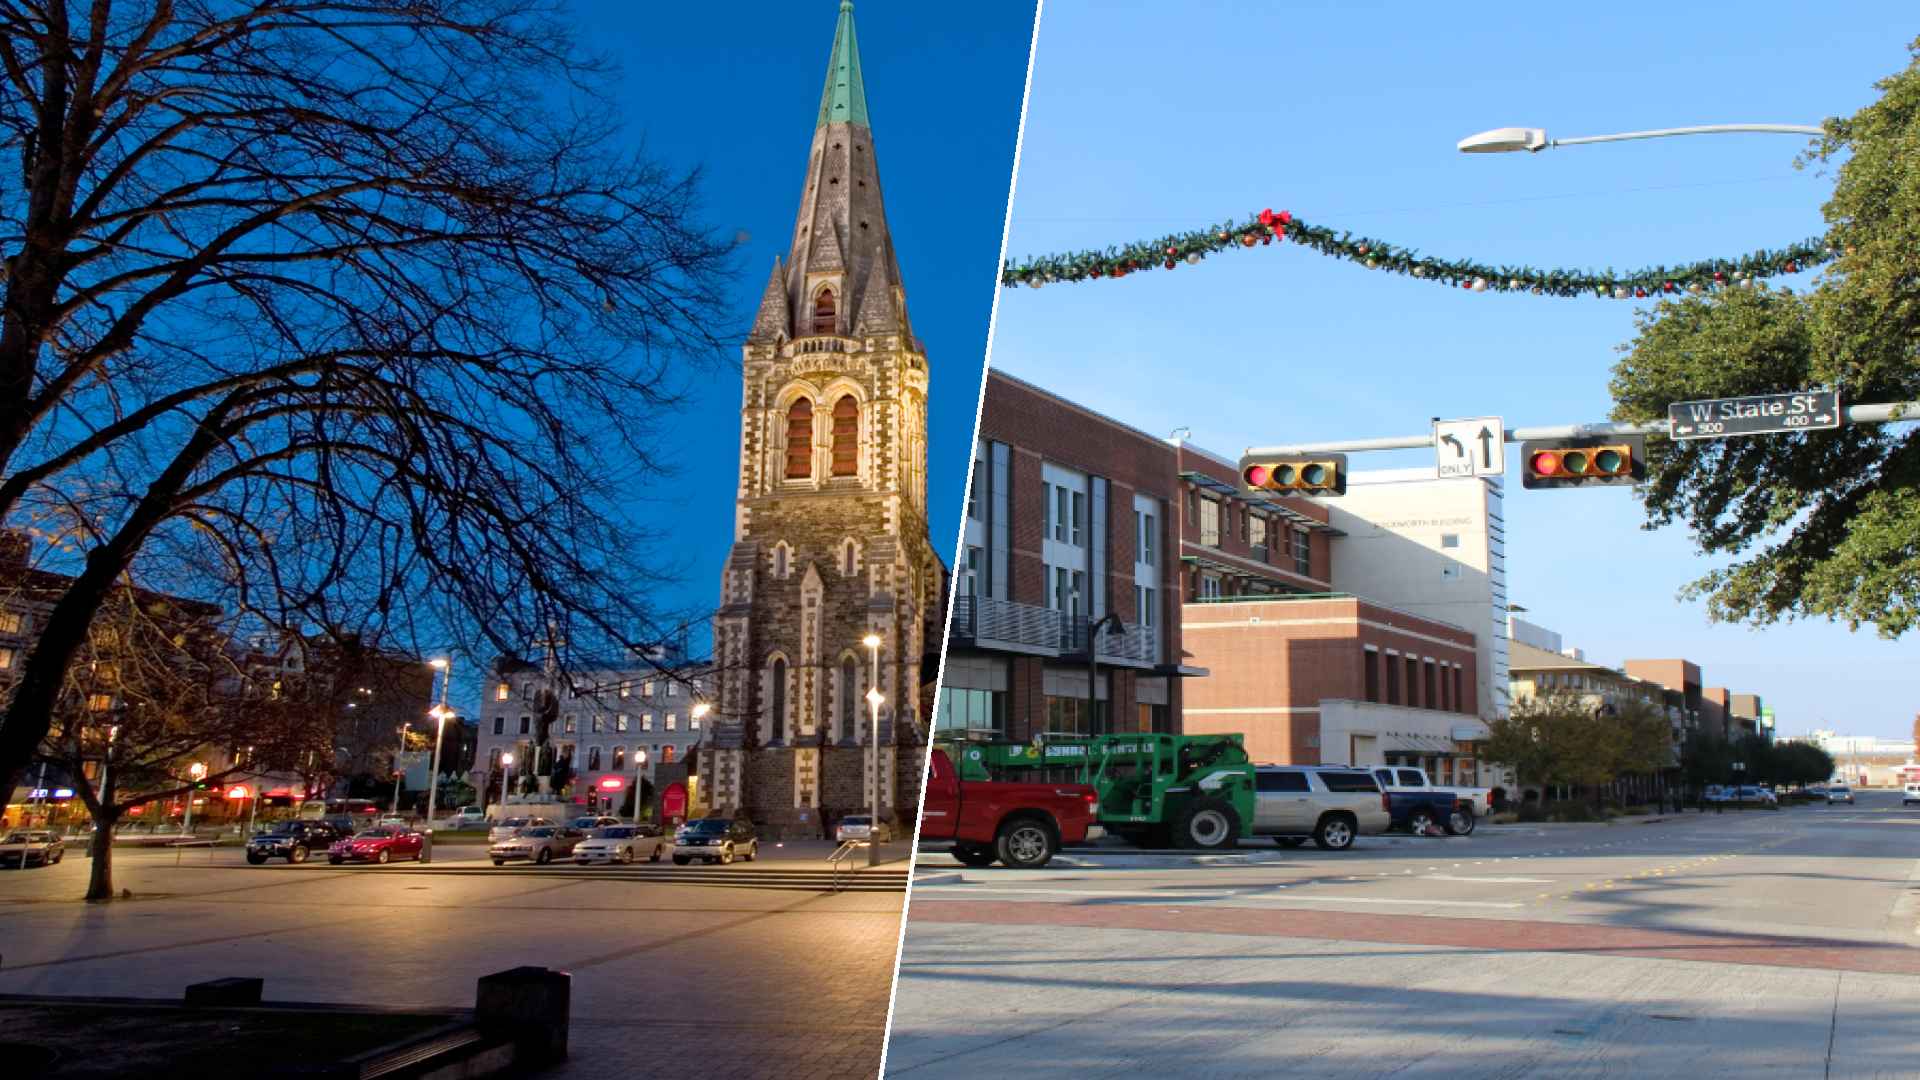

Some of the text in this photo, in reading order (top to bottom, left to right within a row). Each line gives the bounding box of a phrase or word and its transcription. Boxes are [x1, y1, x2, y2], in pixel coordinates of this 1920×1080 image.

[1690, 396, 1817, 421] W State St
[1783, 415, 1809, 426] 400
[1698, 422, 1725, 434] 500
[1440, 464, 1471, 474] ONLY
